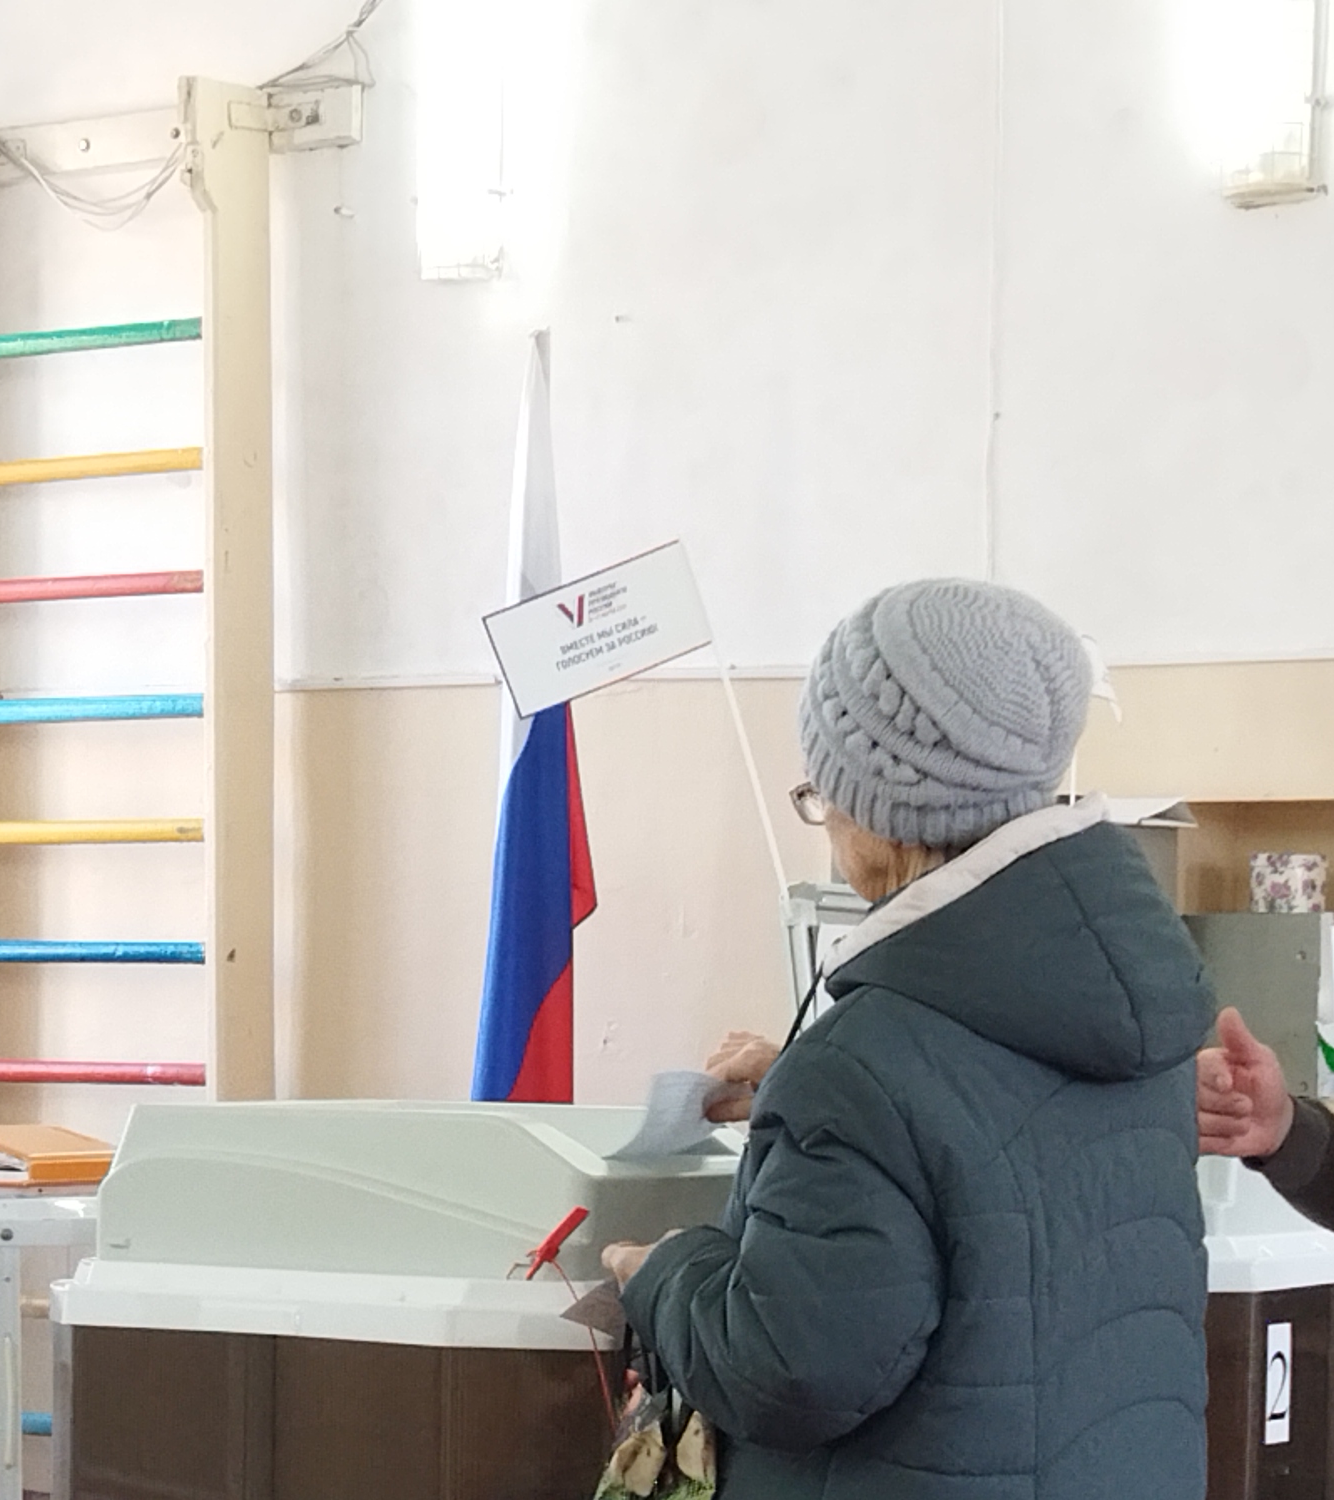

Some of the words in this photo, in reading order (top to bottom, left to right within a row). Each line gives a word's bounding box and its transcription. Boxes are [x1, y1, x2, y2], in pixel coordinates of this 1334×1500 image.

[559, 633, 596, 655] ВМЕСТЕ
[596, 626, 614, 641] МЫ
[614, 616, 639, 633] СИЛА
[556, 645, 604, 672] ГОЛОСУЕМ
[605, 640, 617, 653] ЗА
[1267, 1350, 1288, 1422] 2
